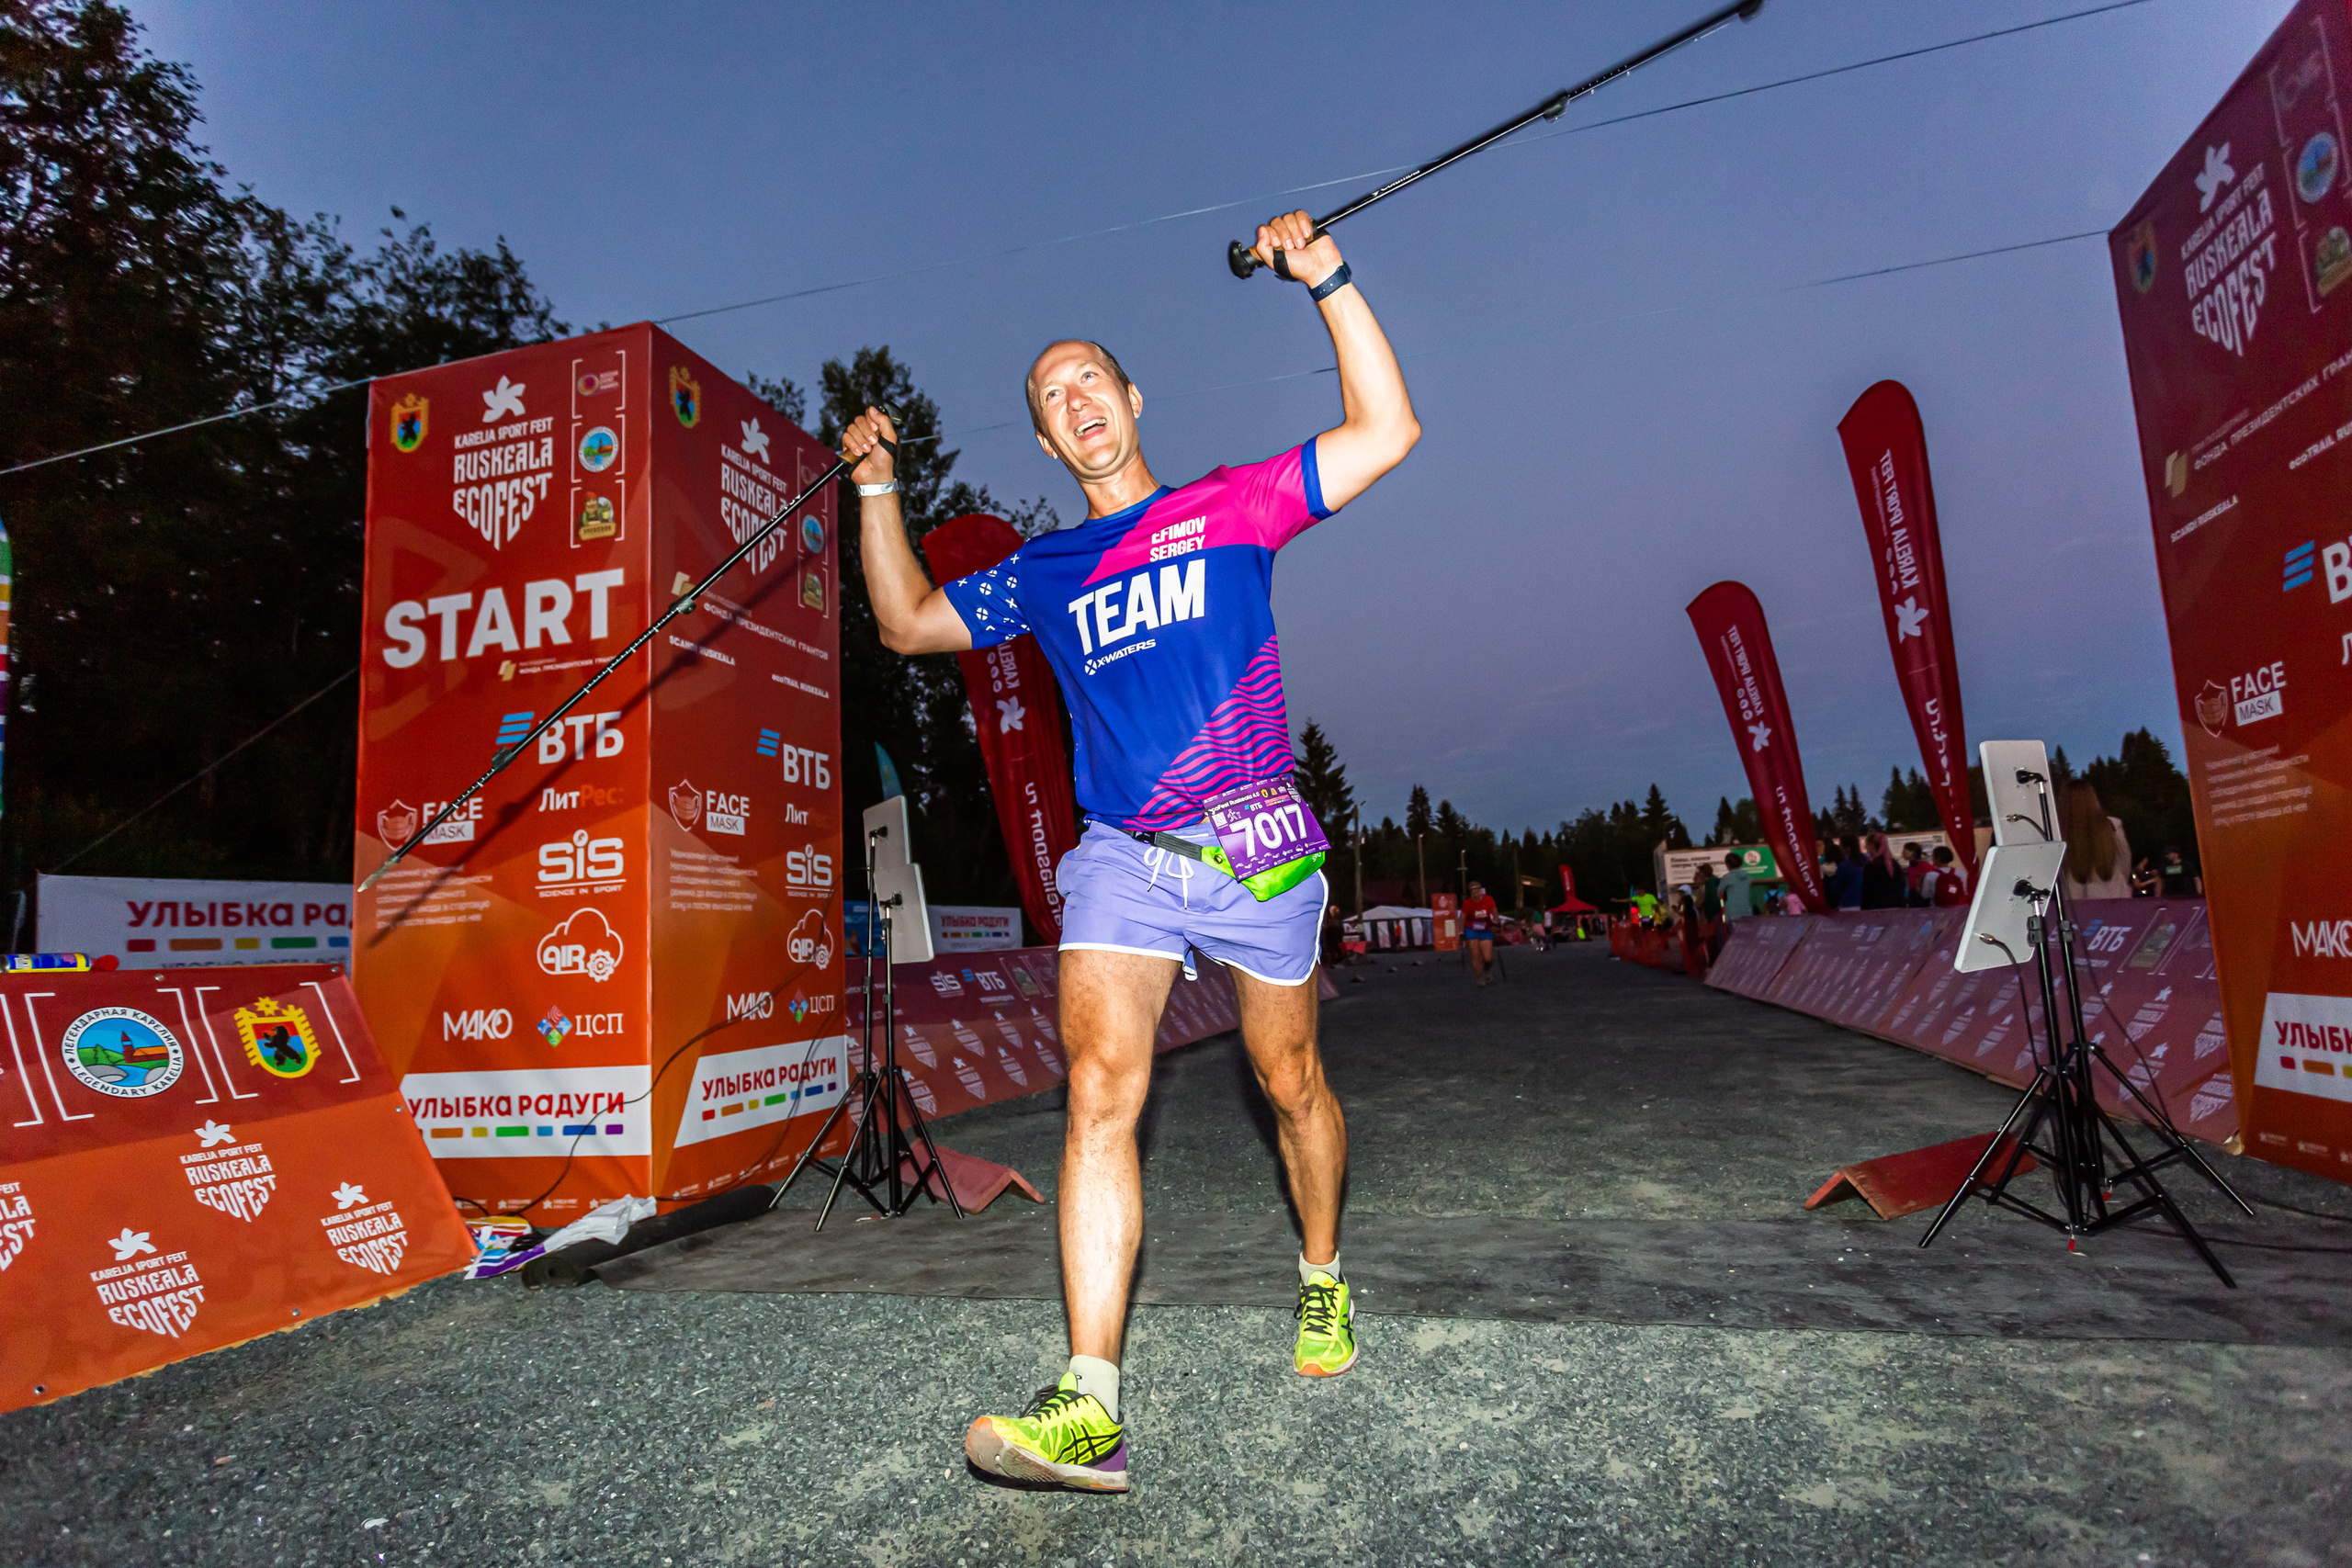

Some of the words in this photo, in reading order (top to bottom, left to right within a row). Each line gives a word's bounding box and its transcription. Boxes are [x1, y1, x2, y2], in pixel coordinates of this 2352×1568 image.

[2184, 187, 2274, 300] RUSKEALA
[2191, 231, 2277, 357] ECOFEST
[455, 429, 496, 449] KARELIA
[498, 422, 527, 440] SPORT
[530, 417, 553, 434] FEST
[454, 437, 553, 484] RUSKEALA
[453, 472, 553, 551] ECOFEST
[1151, 515, 1206, 544] EFIMOV
[1149, 535, 1205, 563] SERGEY
[383, 568, 624, 669] START
[1069, 558, 1205, 656] TEAM
[735, 616, 797, 649] ПРЕЗИДЕНТСКИХ
[798, 641, 829, 660] ГРАНТОВ
[2231, 661, 2287, 702] FACE
[2239, 696, 2274, 721] MASK
[538, 711, 624, 764] ВТБ
[784, 743, 831, 790] ВТБ
[707, 790, 750, 818] FACE
[1250, 802, 1262, 811] ВТБ
[710, 815, 739, 831] MASK
[1229, 804, 1307, 858] 7017
[539, 888, 575, 897] SCIENCE
[579, 886, 588, 895] IN
[594, 885, 622, 895] SPORT
[2087, 926, 2132, 952] ВТБ
[974, 971, 1006, 991] ВТБ
[809, 995, 834, 1014] ЦСП
[64, 1009, 127, 1055] ЛЕГЕНДАРНАЯ
[132, 1011, 178, 1047] КАРЕЛИЯ
[575, 1013, 624, 1037] ЦСП
[72, 1066, 148, 1096] LEGENDARY
[152, 1056, 182, 1091] KARELIA
[180, 1150, 216, 1164] KARELIA
[218, 1145, 243, 1158] SPORT
[244, 1143, 263, 1155] FEST
[185, 1155, 273, 1185] RUSKEALA
[195, 1175, 277, 1223] ECOFEST
[321, 1213, 355, 1227] KARELIA
[356, 1206, 377, 1219] SPORT
[377, 1201, 393, 1212] FEST
[326, 1213, 403, 1247] RUSKEALA
[90, 1264, 134, 1282] KARELIA
[136, 1256, 166, 1271] SPORT
[166, 1250, 188, 1264] FEST
[337, 1231, 409, 1276] ECOFEST
[96, 1264, 200, 1305] RUSKEALA
[108, 1286, 206, 1338] ECOFEST
